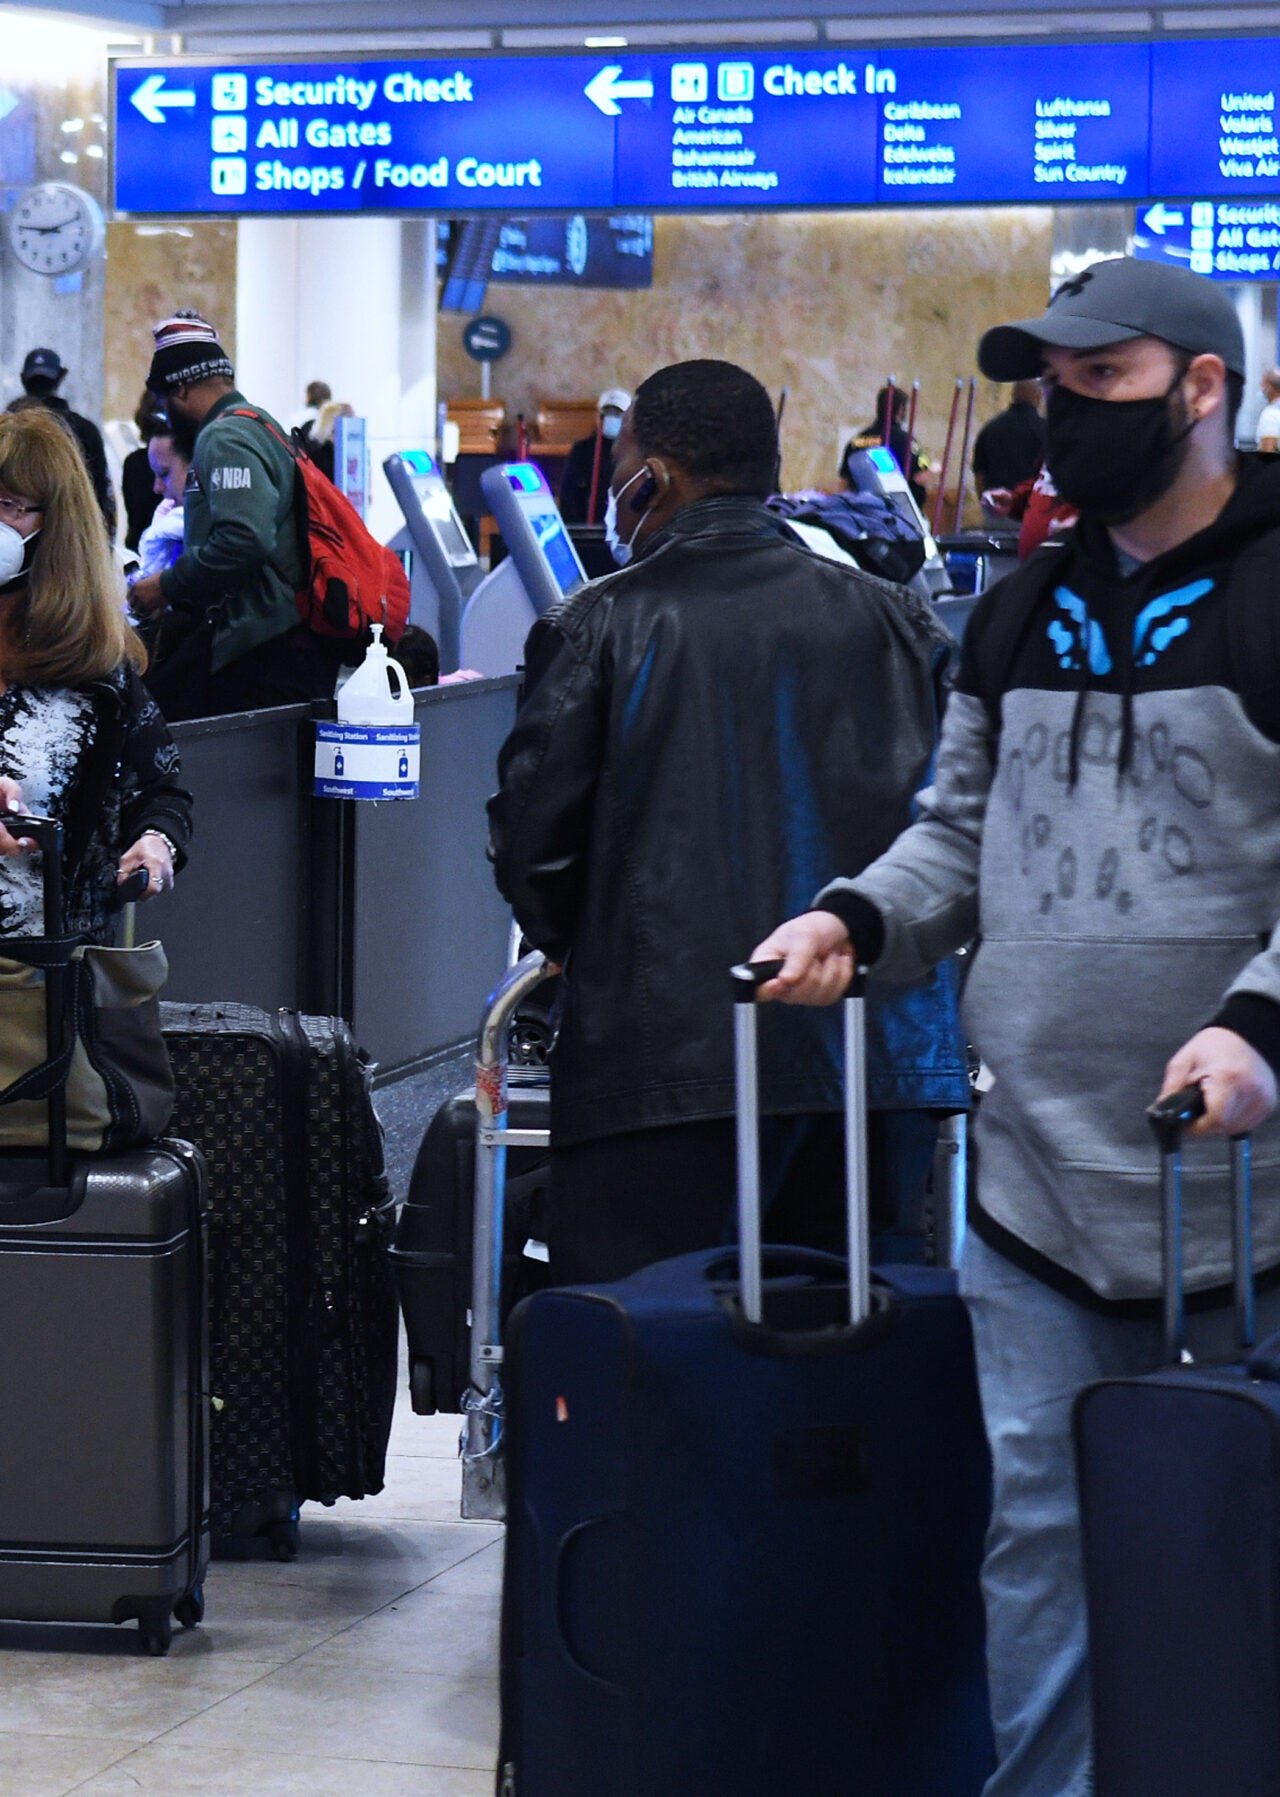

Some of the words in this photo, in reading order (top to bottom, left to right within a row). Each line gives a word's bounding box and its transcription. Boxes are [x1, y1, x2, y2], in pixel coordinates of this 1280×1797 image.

[763, 63, 856, 96] Check
[865, 65, 896, 94] In
[256, 76, 377, 111] Security
[384, 72, 473, 103] Check
[883, 102, 961, 121] Caribbean
[1035, 98, 1111, 117] Lufthansa
[1220, 92, 1274, 112] United
[672, 108, 696, 124] Air
[697, 106, 754, 124] Canada
[1219, 114, 1273, 134] Volaris
[256, 118, 299, 149] All
[306, 119, 392, 148] Gates
[672, 129, 743, 146] American
[883, 124, 925, 142] Delta
[1034, 121, 1077, 140] Silver
[672, 149, 756, 167] Bahamasair
[883, 145, 955, 164] Edelweiss
[1034, 142, 1076, 164] Spirit
[255, 161, 344, 196] Shops
[352, 162, 366, 189] /
[375, 157, 448, 187] Food
[456, 158, 541, 187] Court
[883, 167, 956, 185] Icelandair
[1033, 164, 1064, 183] Sun
[1065, 164, 1127, 185] Country
[1218, 159, 1254, 178] Viva
[672, 171, 719, 188] British
[719, 170, 778, 190] Airways
[1217, 227, 1244, 248] All
[1245, 228, 1280, 248] Gat
[1214, 251, 1270, 274] Shops
[222, 467, 251, 489] NBA
